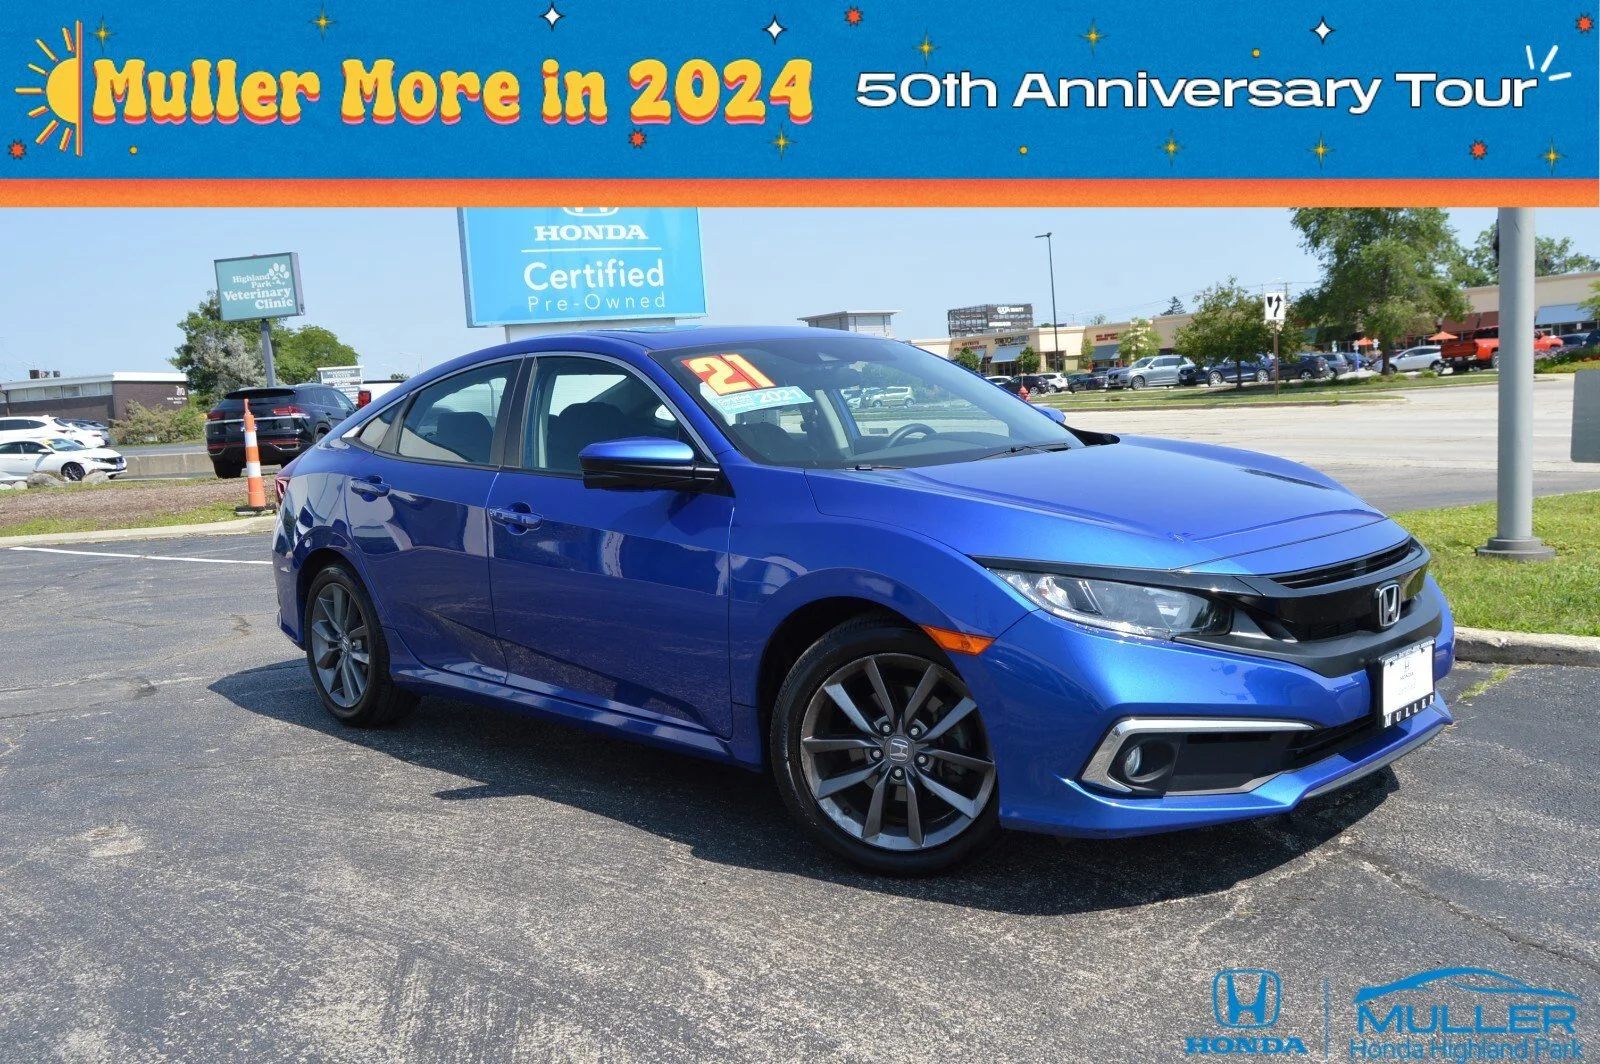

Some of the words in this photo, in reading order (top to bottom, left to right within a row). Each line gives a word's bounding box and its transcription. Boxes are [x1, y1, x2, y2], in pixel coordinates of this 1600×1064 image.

[533, 224, 649, 242] HONDA
[232, 272, 271, 284] Highland
[523, 258, 665, 291] Certified
[250, 280, 272, 289] Park
[222, 287, 292, 302] Veterinary
[527, 291, 666, 313] Pre-Owned
[254, 297, 294, 310] Clinic
[687, 353, 777, 396] 21
[754, 388, 804, 404] 2021
[1383, 694, 1435, 728] MULLER
